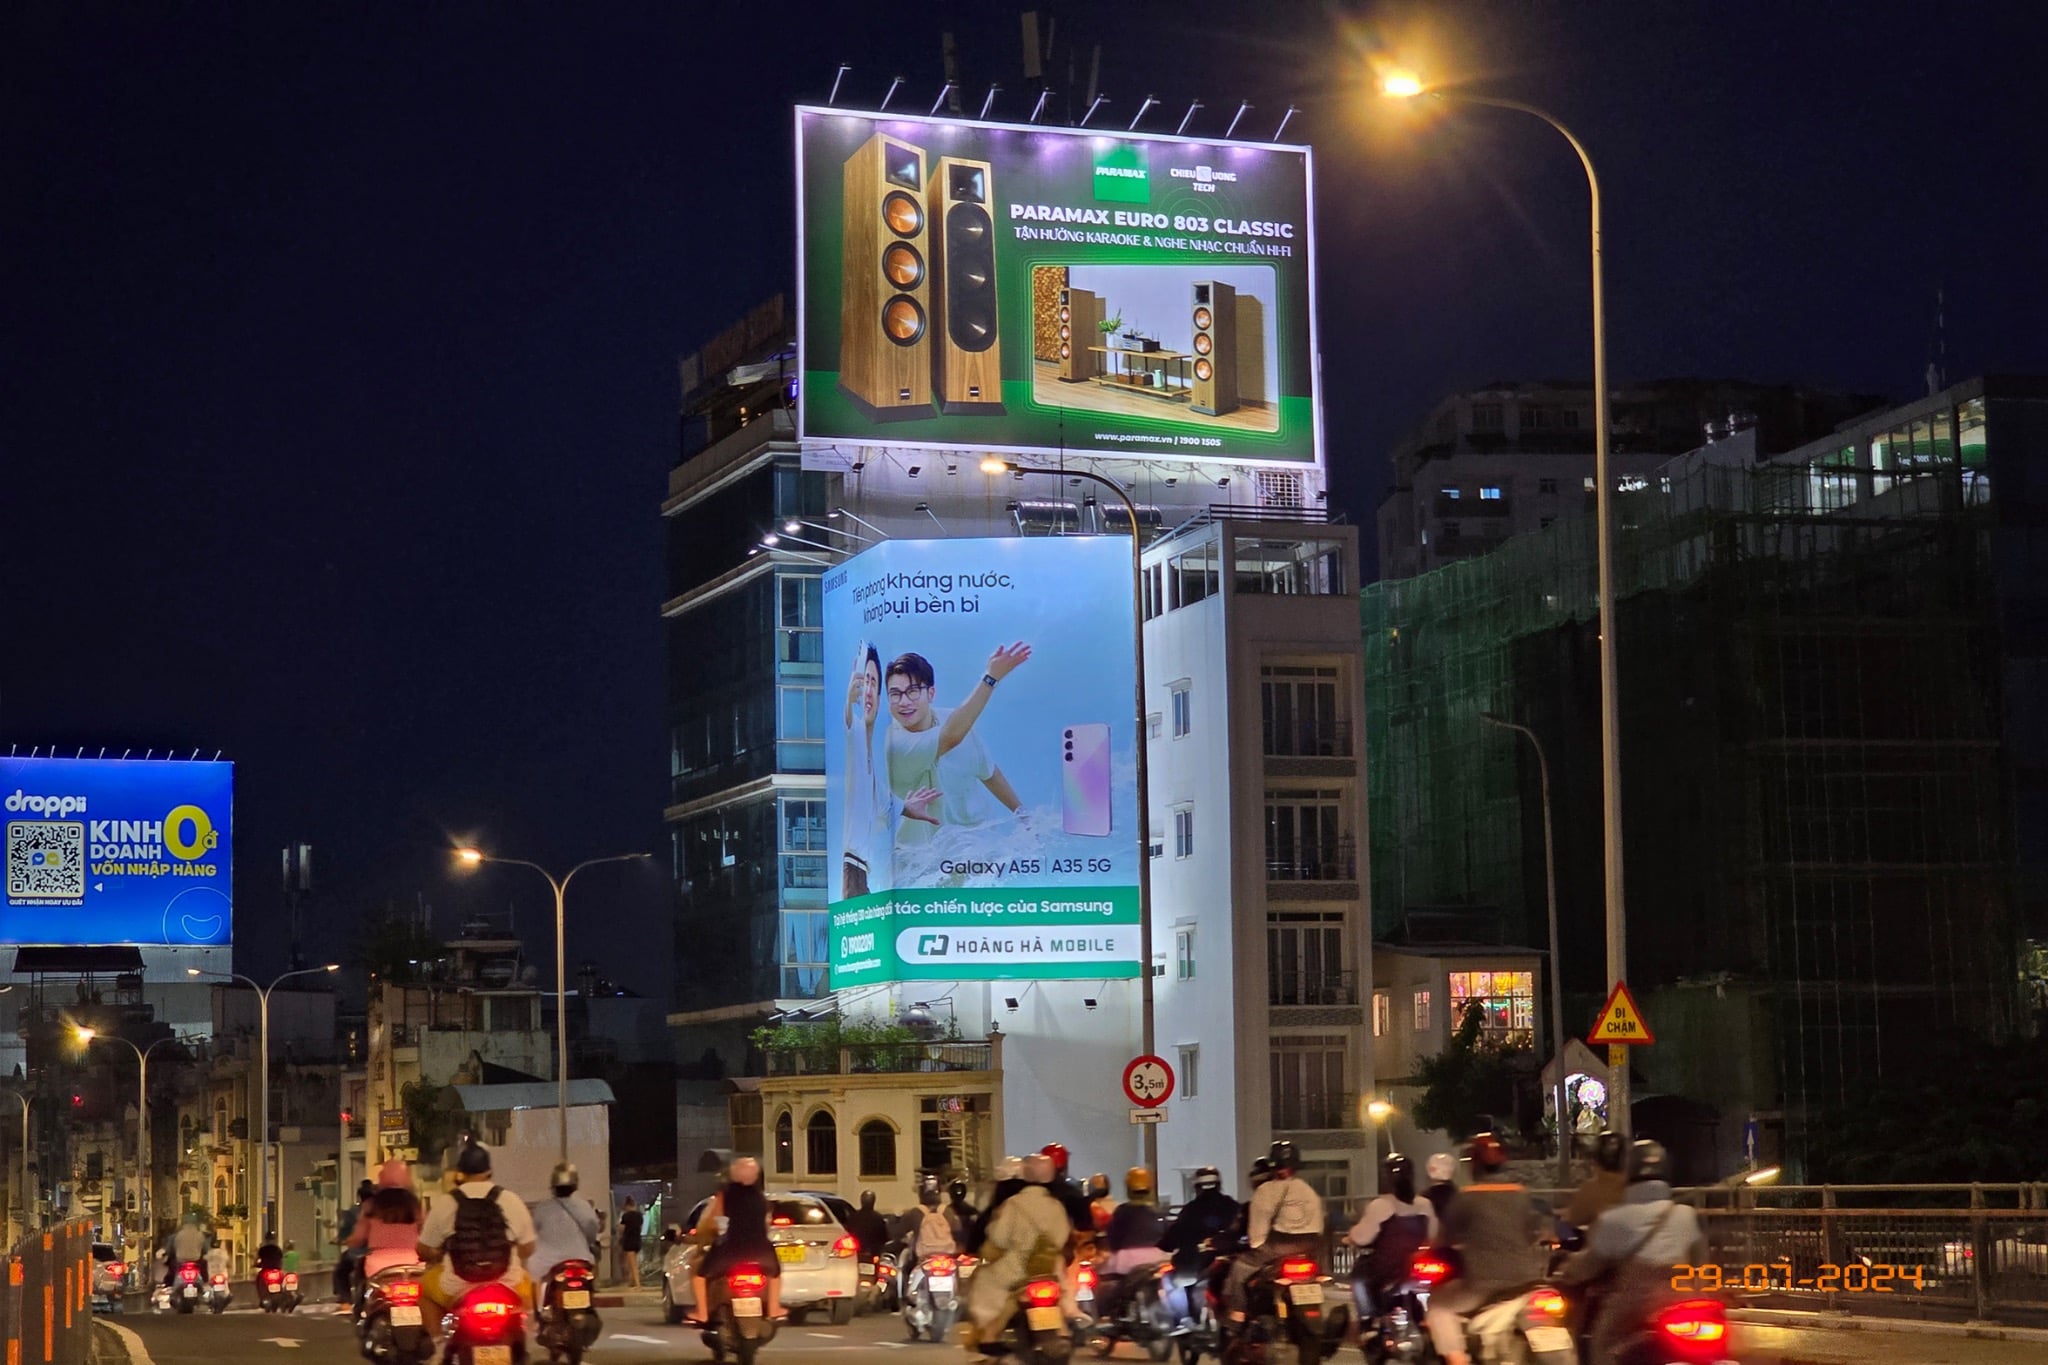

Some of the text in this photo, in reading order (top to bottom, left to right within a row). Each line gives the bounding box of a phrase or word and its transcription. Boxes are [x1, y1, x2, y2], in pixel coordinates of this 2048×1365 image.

[1095, 167, 1146, 179] PARAMAX
[1192, 182, 1215, 192] TECH
[1010, 204, 1294, 238] PARAMAX EURO 803 CLASSIC
[1014, 225, 1292, 257] TẬN HƯỞNG KARAOKE & NGHE NHẠC CHUẨN HI-FI
[1094, 432, 1172, 444] www.paramax.vn
[1180, 437, 1200, 446] 1900
[824, 570, 848, 595] SAMSUNG
[865, 577, 885, 604] phong
[887, 570, 952, 593] kháng
[958, 570, 1014, 590] nước,
[884, 596, 909, 619] bụi
[915, 592, 955, 614] bền
[961, 594, 979, 613] bỉ
[5, 789, 87, 818] droppii
[90, 820, 162, 843] KINH
[90, 844, 162, 860] DOANH
[91, 859, 217, 879] VỐN NHẬP HÀNG
[940, 859, 1005, 878] Galaxy
[1008, 859, 1041, 874] A55
[1051, 859, 1083, 873] A35
[1087, 858, 1112, 873] 5G
[895, 900, 921, 914] tác
[924, 897, 967, 914] chiến
[971, 899, 1003, 917] lược
[1007, 898, 1037, 914] của
[1041, 900, 1113, 915] Samsung
[956, 936, 1115, 953] HOÀNG HÀ MOBILE
[1615, 1007, 1626, 1019] ĐI
[1134, 1074, 1165, 1093] 3,5m
